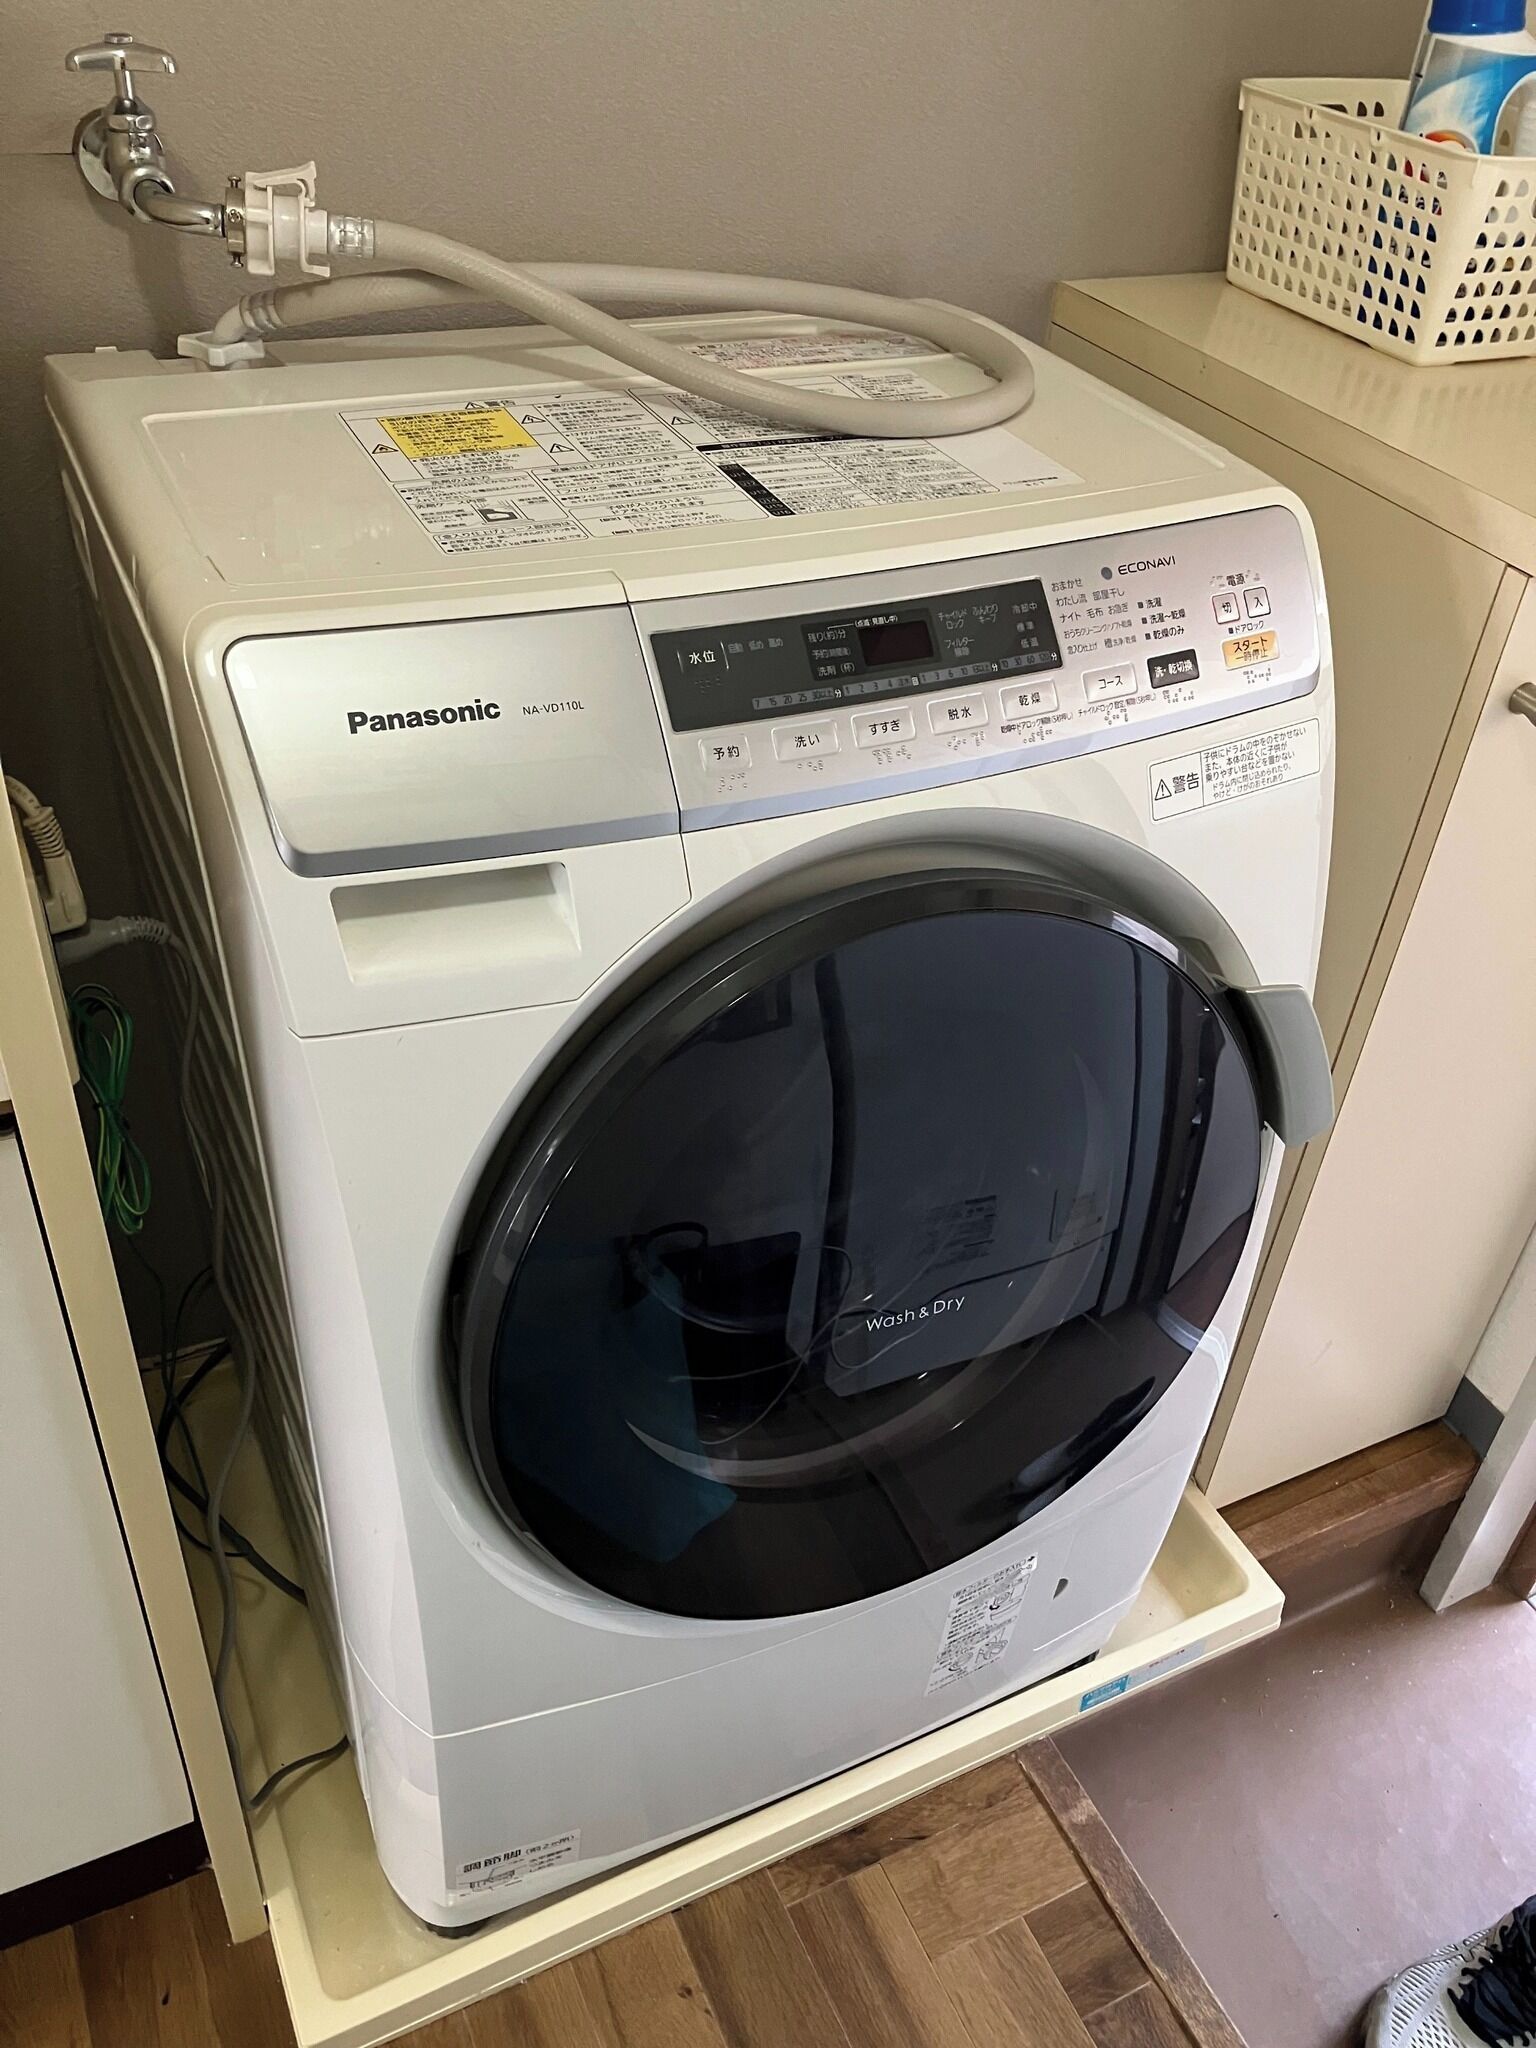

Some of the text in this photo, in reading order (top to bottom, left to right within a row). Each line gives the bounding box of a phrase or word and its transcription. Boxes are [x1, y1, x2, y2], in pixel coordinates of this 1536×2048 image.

[1118, 555, 1176, 576] ECONAVI
[1051, 578, 1083, 592] おまかせ
[1226, 573, 1246, 587] 電源
[1145, 597, 1162, 609] 洗濯
[1221, 602, 1232, 613] 切
[1254, 596, 1264, 607] 入
[978, 613, 998, 624] キープ
[1060, 602, 1129, 624] ナイト 毛布 お急ぎ
[946, 619, 965, 631] ロック
[1234, 620, 1265, 634] ドアロック
[1153, 626, 1185, 640] 乾燥のみ
[944, 636, 975, 650] フィルター
[1233, 637, 1269, 653] スタート
[688, 649, 718, 666] 水位
[1050, 651, 1059, 662] 分
[817, 665, 837, 677] 洗剤
[990, 662, 999, 673] 分
[1098, 674, 1123, 691] コース
[834, 688, 843, 699] 分
[1018, 691, 1041, 707] 乾燥
[346, 698, 585, 735] Panasonic NA-VD110L
[947, 705, 972, 720] 脱水
[868, 719, 901, 736] すすぎ
[794, 733, 820, 748] 洗い
[713, 745, 740, 761] 予約
[1172, 772, 1200, 795] 警告
[866, 1296, 965, 1332] Wash & Dry
